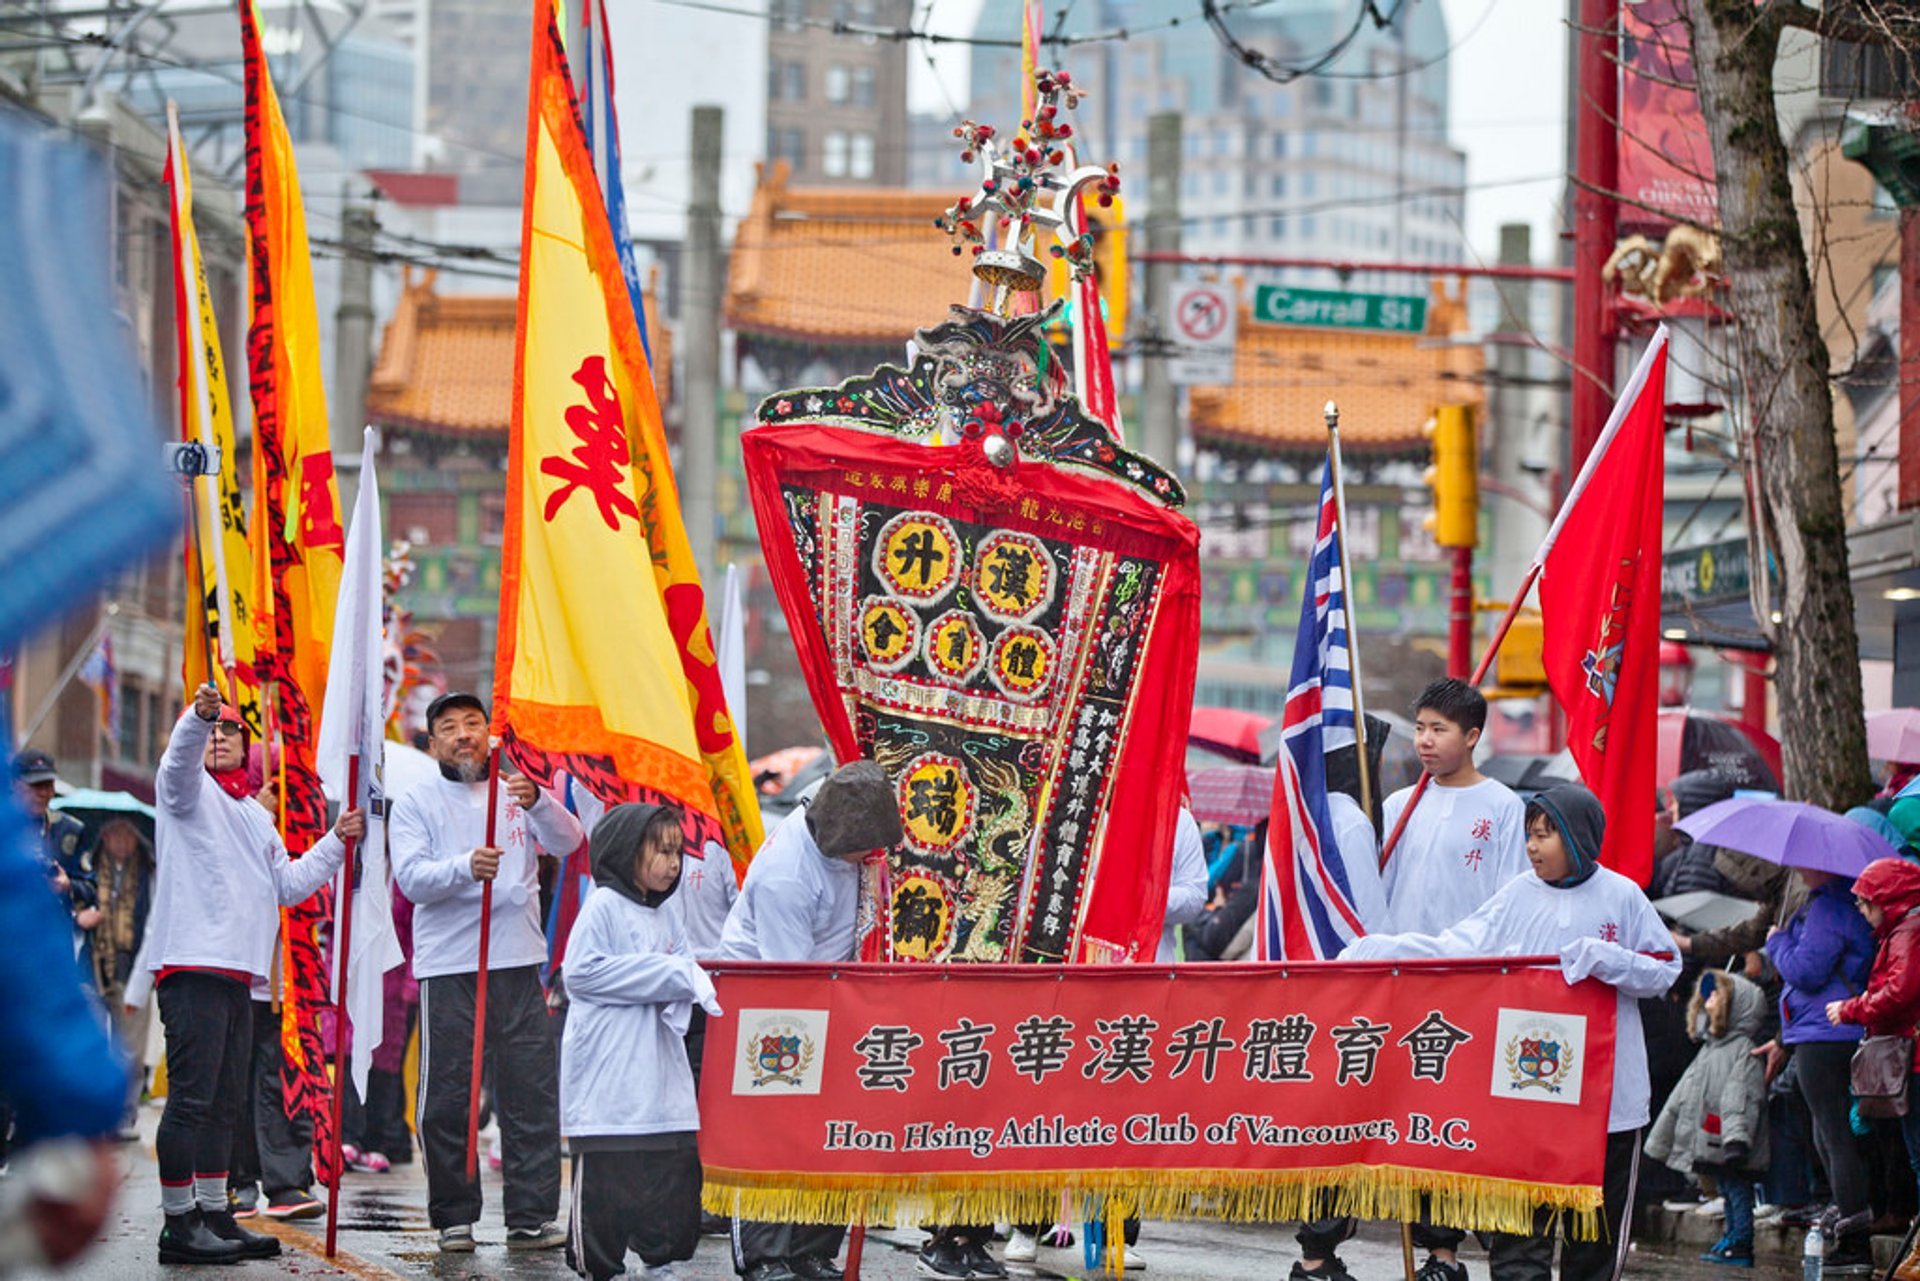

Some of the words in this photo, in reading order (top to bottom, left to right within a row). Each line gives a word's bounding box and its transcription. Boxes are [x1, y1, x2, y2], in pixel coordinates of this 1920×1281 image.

[1638, 187, 1718, 207] CHINATO
[1268, 291, 1368, 323] Carrall
[1379, 300, 1412, 330] St
[1464, 818, 1494, 872] 漢升
[687, 869, 705, 890] 升
[1599, 922, 1620, 943] 漢
[853, 1009, 1473, 1092] 雲高華漢升體育會
[825, 1120, 894, 1151] Hon
[902, 1121, 993, 1156] Hsing
[997, 1115, 1115, 1147] Athletic
[1123, 1113, 1197, 1145] Club
[1205, 1114, 1243, 1145] of
[1243, 1116, 1398, 1147] Vancouver,
[1407, 1114, 1477, 1151] B.C.
